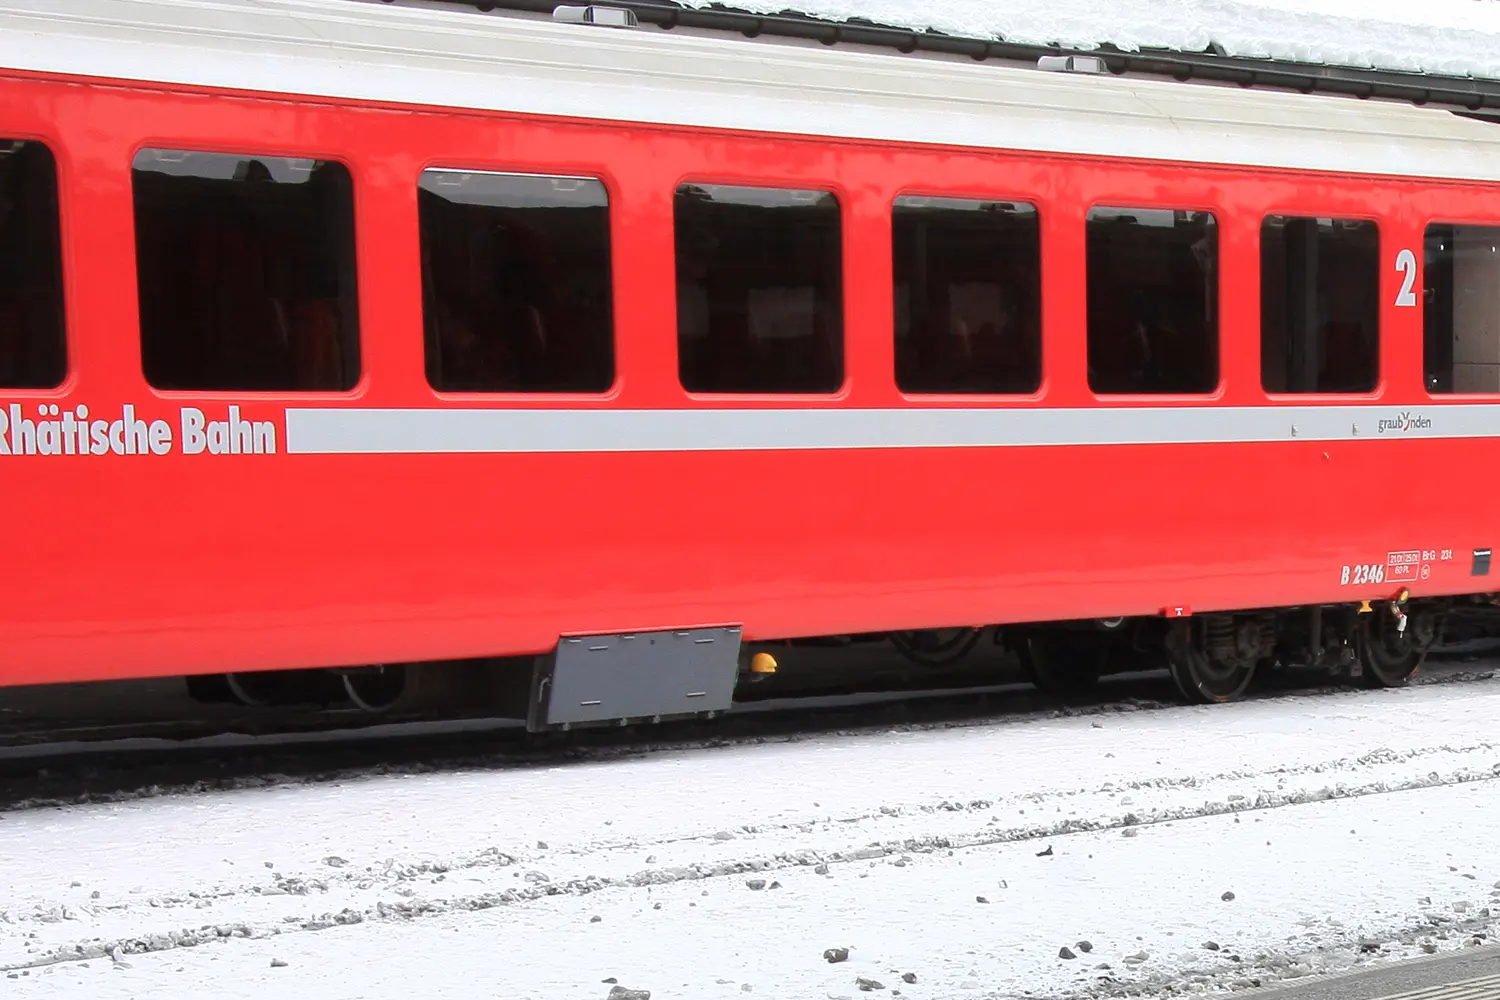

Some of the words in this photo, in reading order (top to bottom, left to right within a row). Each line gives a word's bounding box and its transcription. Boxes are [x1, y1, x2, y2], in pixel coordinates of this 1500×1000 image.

[1394, 248, 1417, 307] 2
[180, 404, 277, 456] Bahn
[1340, 566, 1350, 585] B
[1352, 564, 1384, 584] 2346
